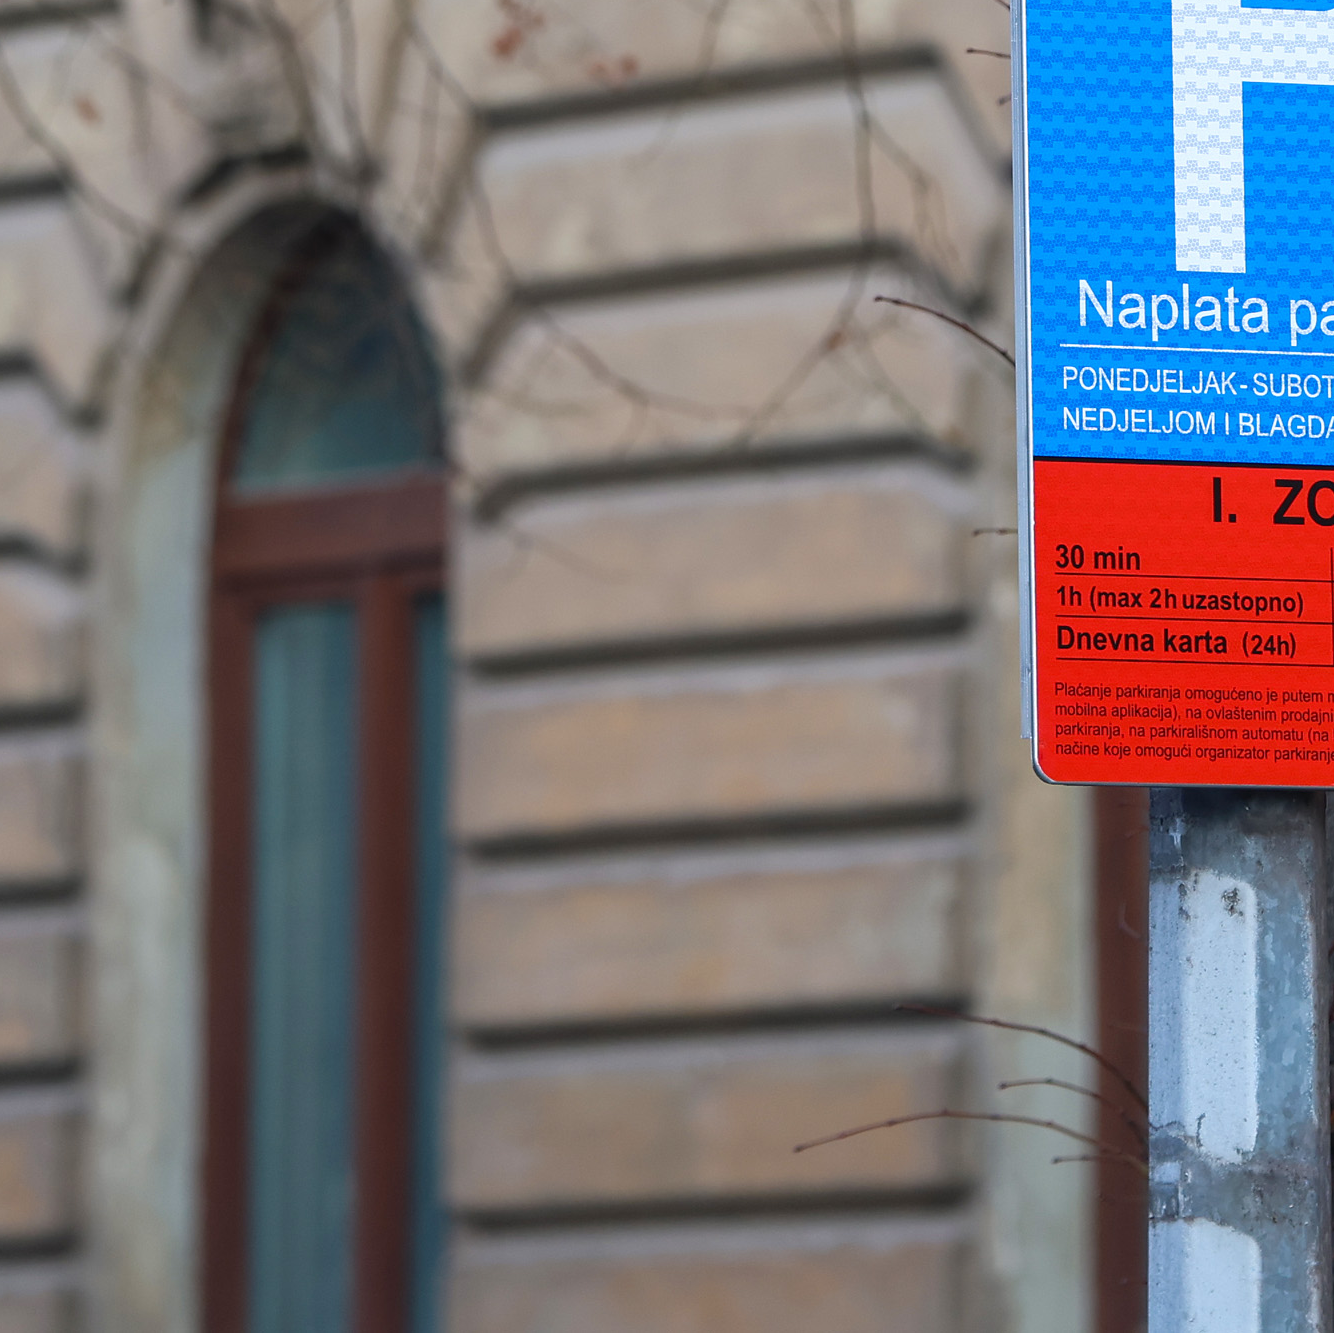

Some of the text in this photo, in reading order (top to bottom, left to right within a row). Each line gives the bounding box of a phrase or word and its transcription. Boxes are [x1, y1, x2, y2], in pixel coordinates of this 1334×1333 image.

[1080, 280, 1269, 341] Naplata
[1064, 407, 1215, 434] NEDJELJOM
[1225, 413, 1229, 435] I
[1213, 477, 1236, 522] I.
[1056, 545, 1084, 568] 30
[1095, 546, 1140, 570] min
[1057, 586, 1081, 605] 1h
[1091, 587, 1142, 611] (max
[1150, 588, 1176, 608] 2h
[1183, 592, 1303, 617] uzastopno)
[1058, 626, 1154, 651] Dnevna
[1164, 629, 1227, 653] karta
[1243, 632, 1295, 658] (24h)
[1055, 682, 1111, 700] Plaćanje
[1116, 685, 1180, 702] parkiranja
[1185, 689, 1262, 703] omogućeno
[1267, 689, 1278, 704] je
[1283, 690, 1323, 704] putem
[1056, 703, 1106, 716] mobilna
[1112, 704, 1180, 721] aplikacija),
[1186, 709, 1201, 718] na
[1206, 707, 1276, 720] ovlaštenim
[1056, 722, 1124, 739] parkiranja,
[1129, 727, 1145, 736] na
[1150, 725, 1237, 740] parkirališnom
[1243, 728, 1303, 740] automatu
[1309, 729, 1328, 744] (na
[1056, 742, 1099, 755] načine
[1104, 743, 1131, 759] koje
[1136, 744, 1191, 760] omogući
[1196, 748, 1270, 761] organizator
